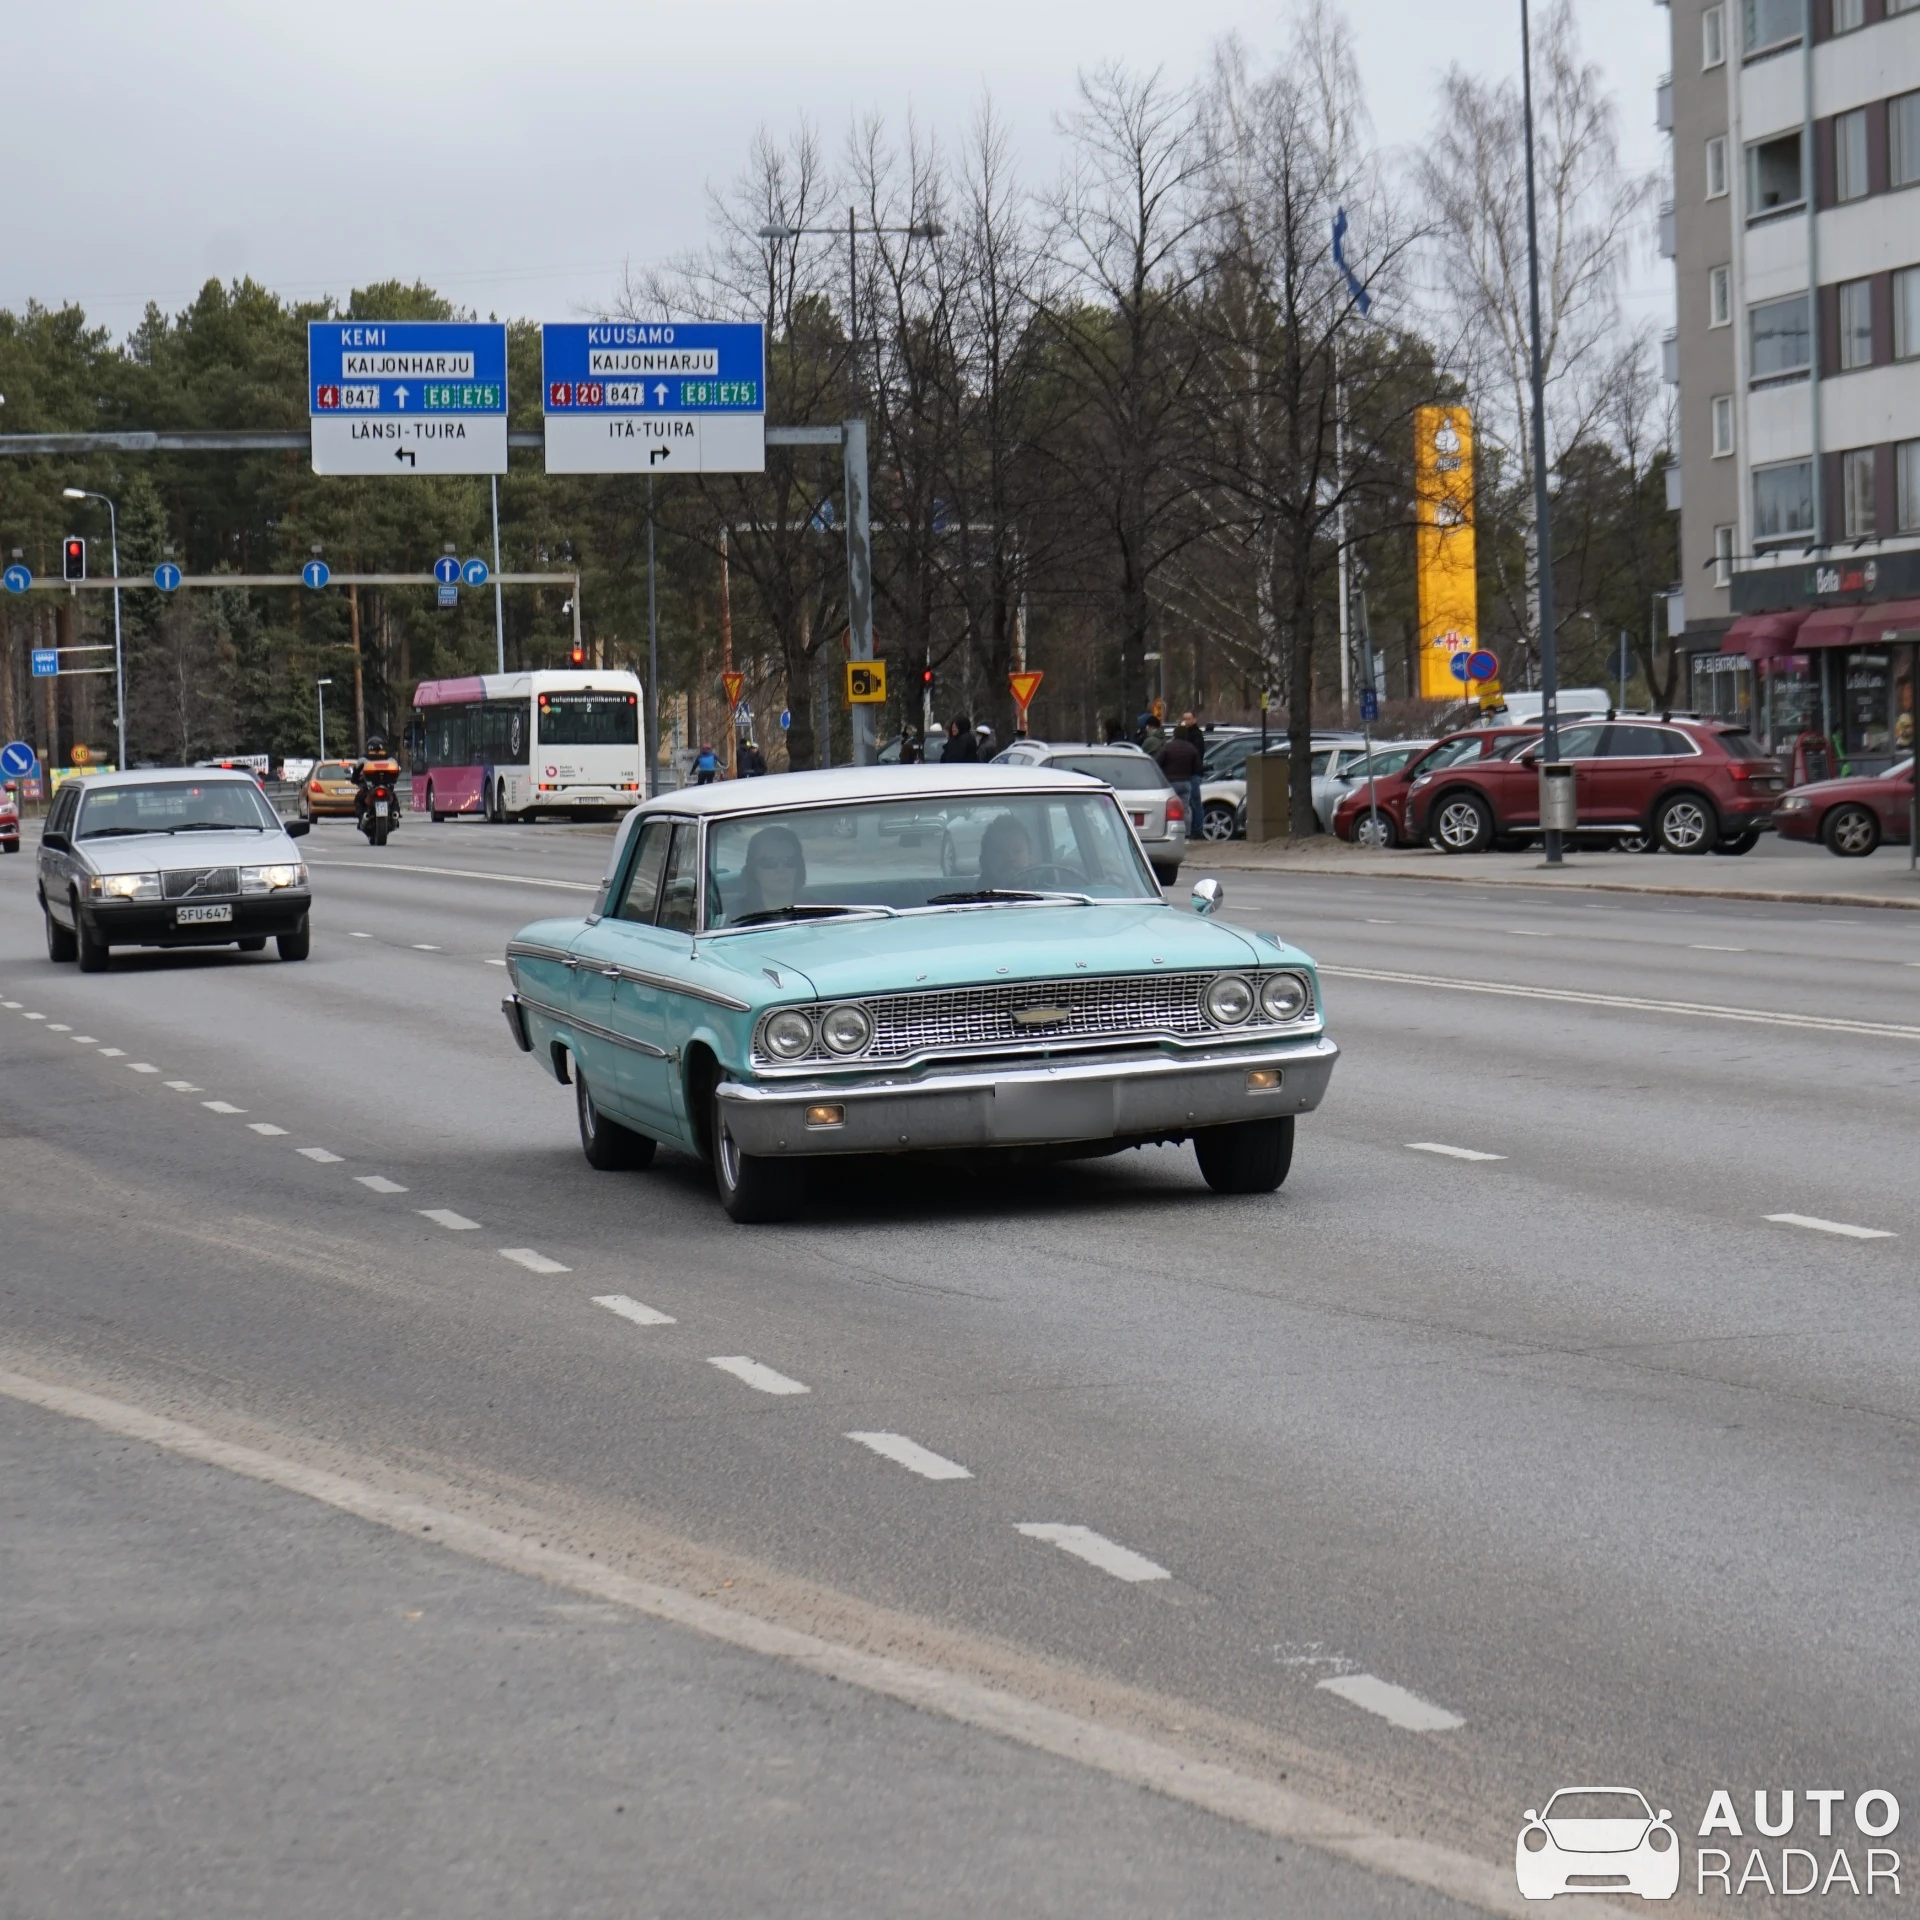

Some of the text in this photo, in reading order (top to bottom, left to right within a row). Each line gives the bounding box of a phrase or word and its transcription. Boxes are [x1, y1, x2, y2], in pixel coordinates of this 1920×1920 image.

[341, 328, 386, 346] KEMI
[588, 326, 675, 344] KUUSAMO
[347, 357, 470, 373] KAIJONHARJU
[593, 354, 714, 370] KAIJONHARJU
[323, 388, 494, 405] 4 847 E8 E75
[555, 386, 750, 402] 4 20 847 E8 E75
[352, 420, 466, 439] LÄNSI-TUIRA
[609, 420, 695, 438] ITÄ-TUIRA
[1816, 567, 1840, 594] Bella
[586, 703, 592, 713] 2
[75, 750, 87, 760] 60
[180, 907, 229, 921] SFU-647
